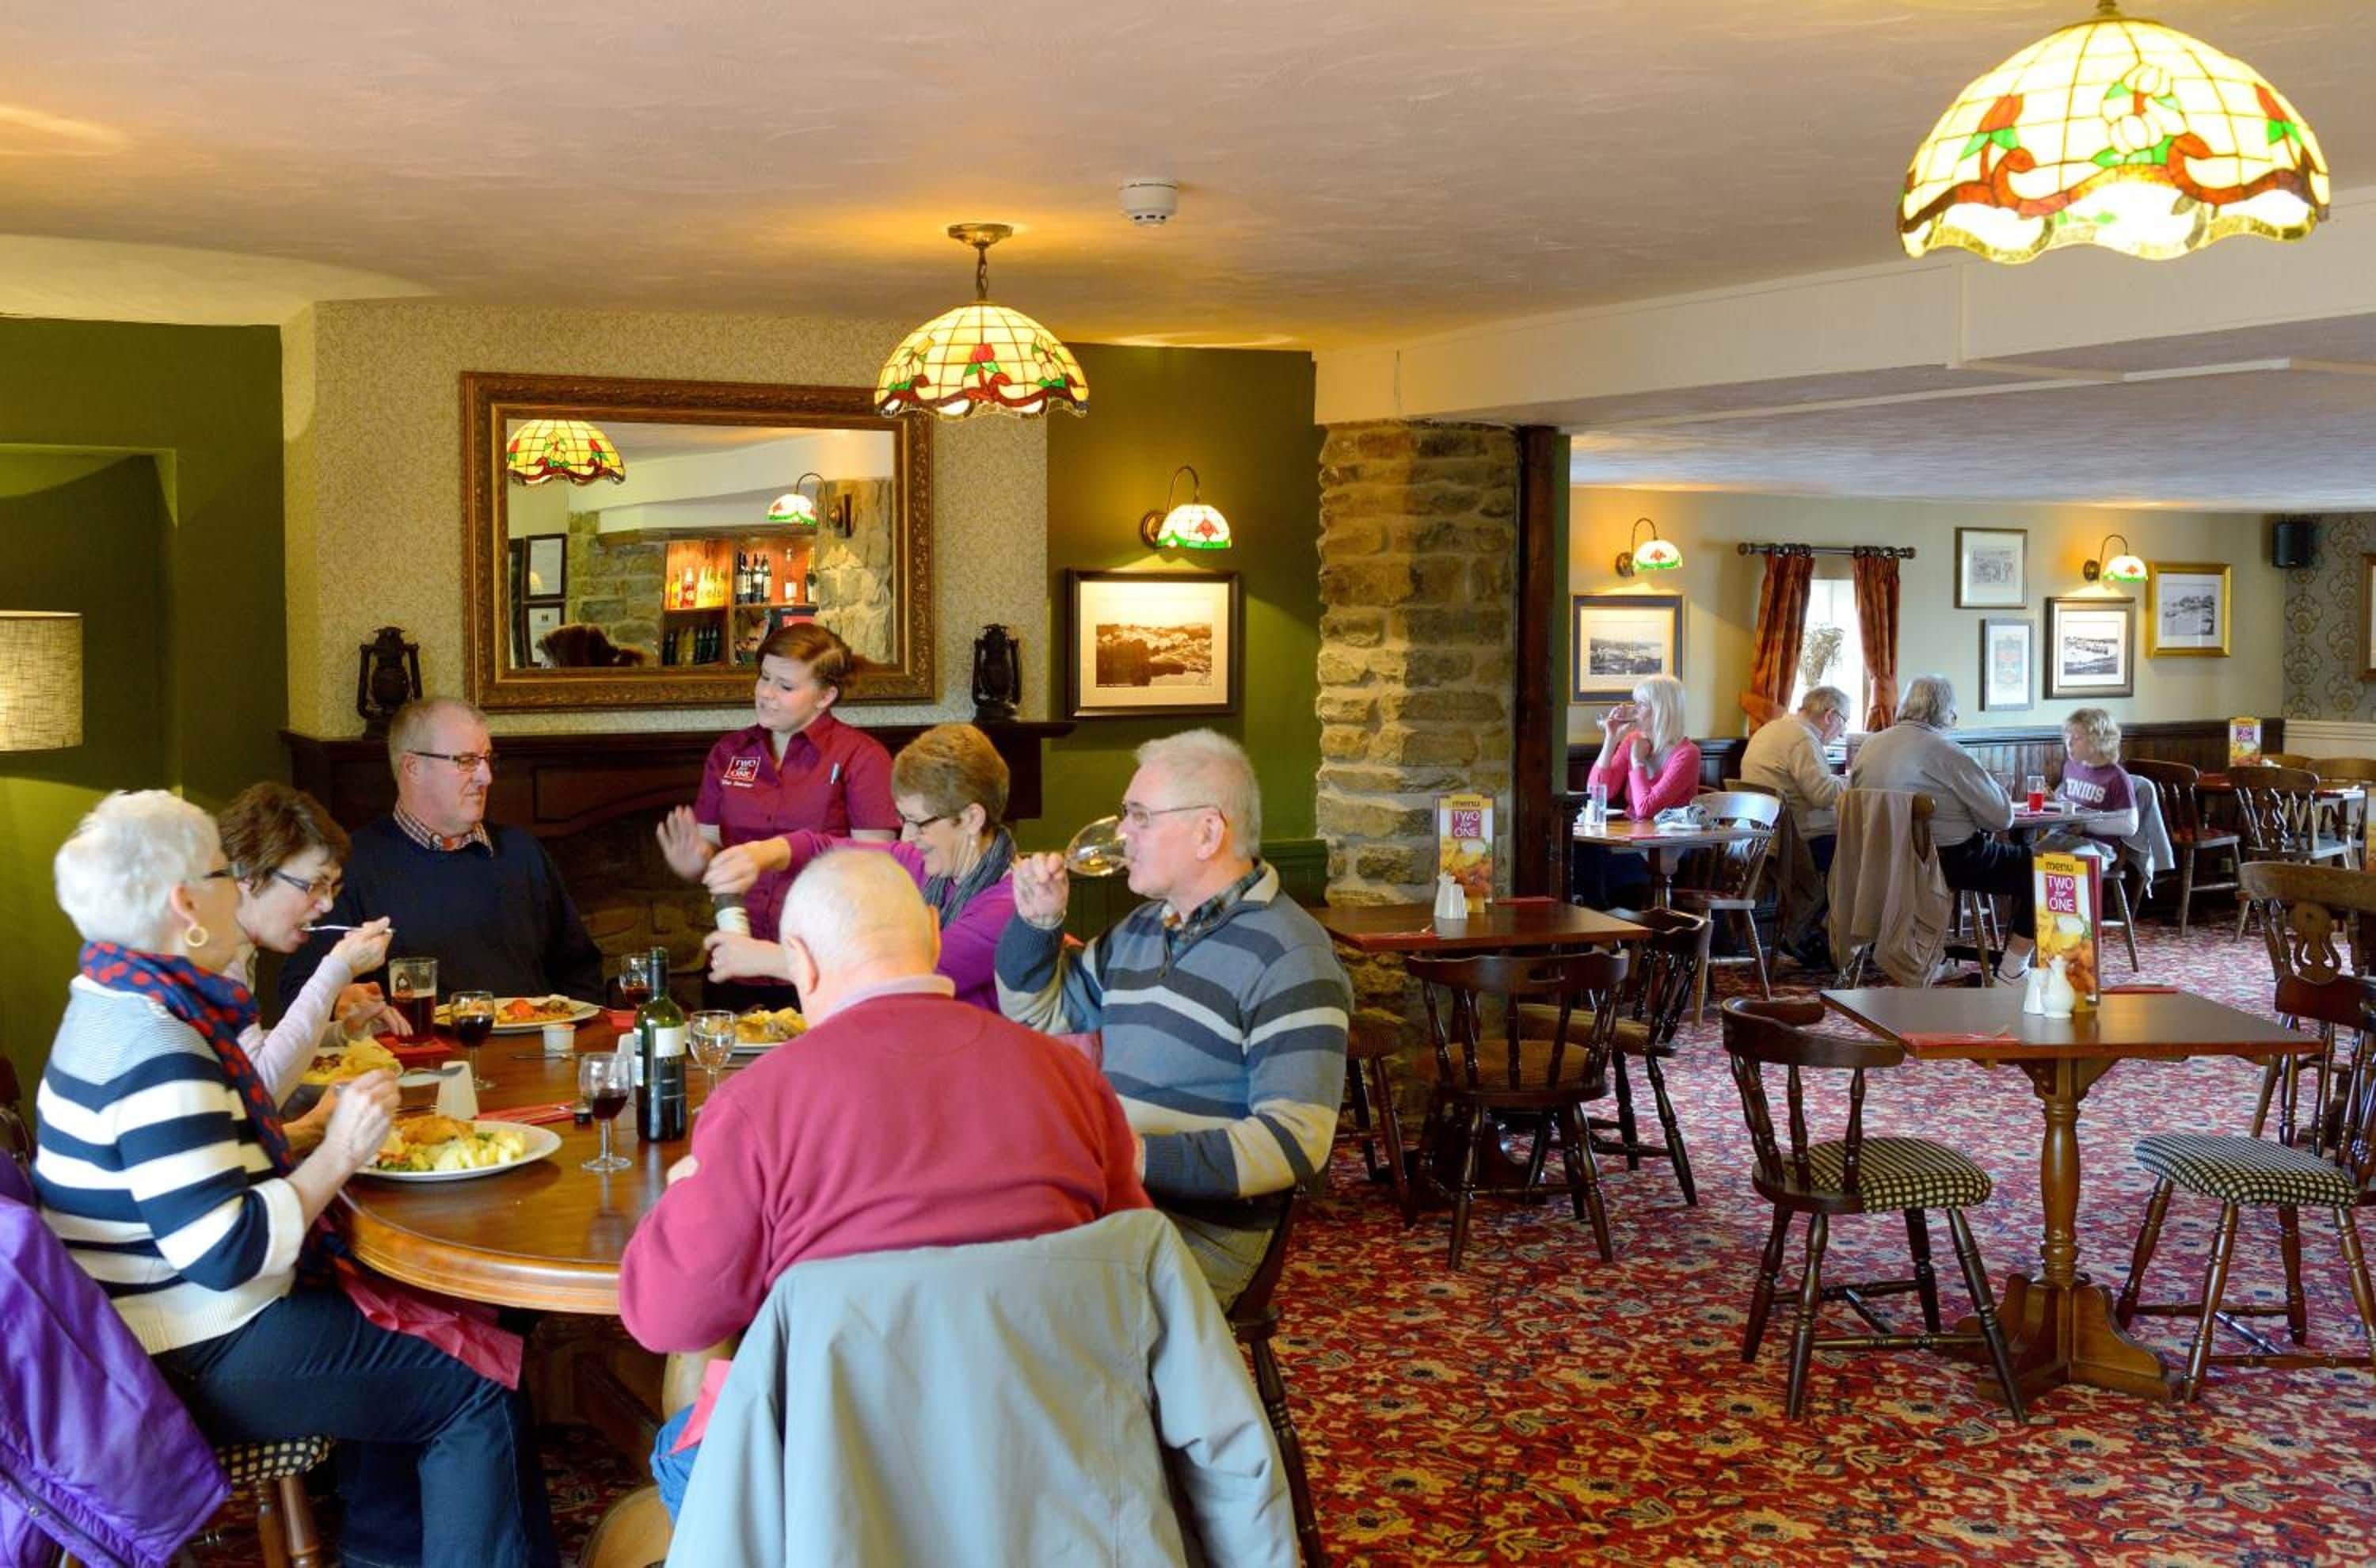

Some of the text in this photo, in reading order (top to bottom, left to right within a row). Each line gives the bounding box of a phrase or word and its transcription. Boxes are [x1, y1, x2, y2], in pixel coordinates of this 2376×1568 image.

[1454, 810, 1480, 821] TWO
[1454, 828, 1478, 837] ONE
[2047, 862, 2074, 872] menu
[2047, 875, 2074, 891] TWO
[2049, 897, 2074, 912] ONE
